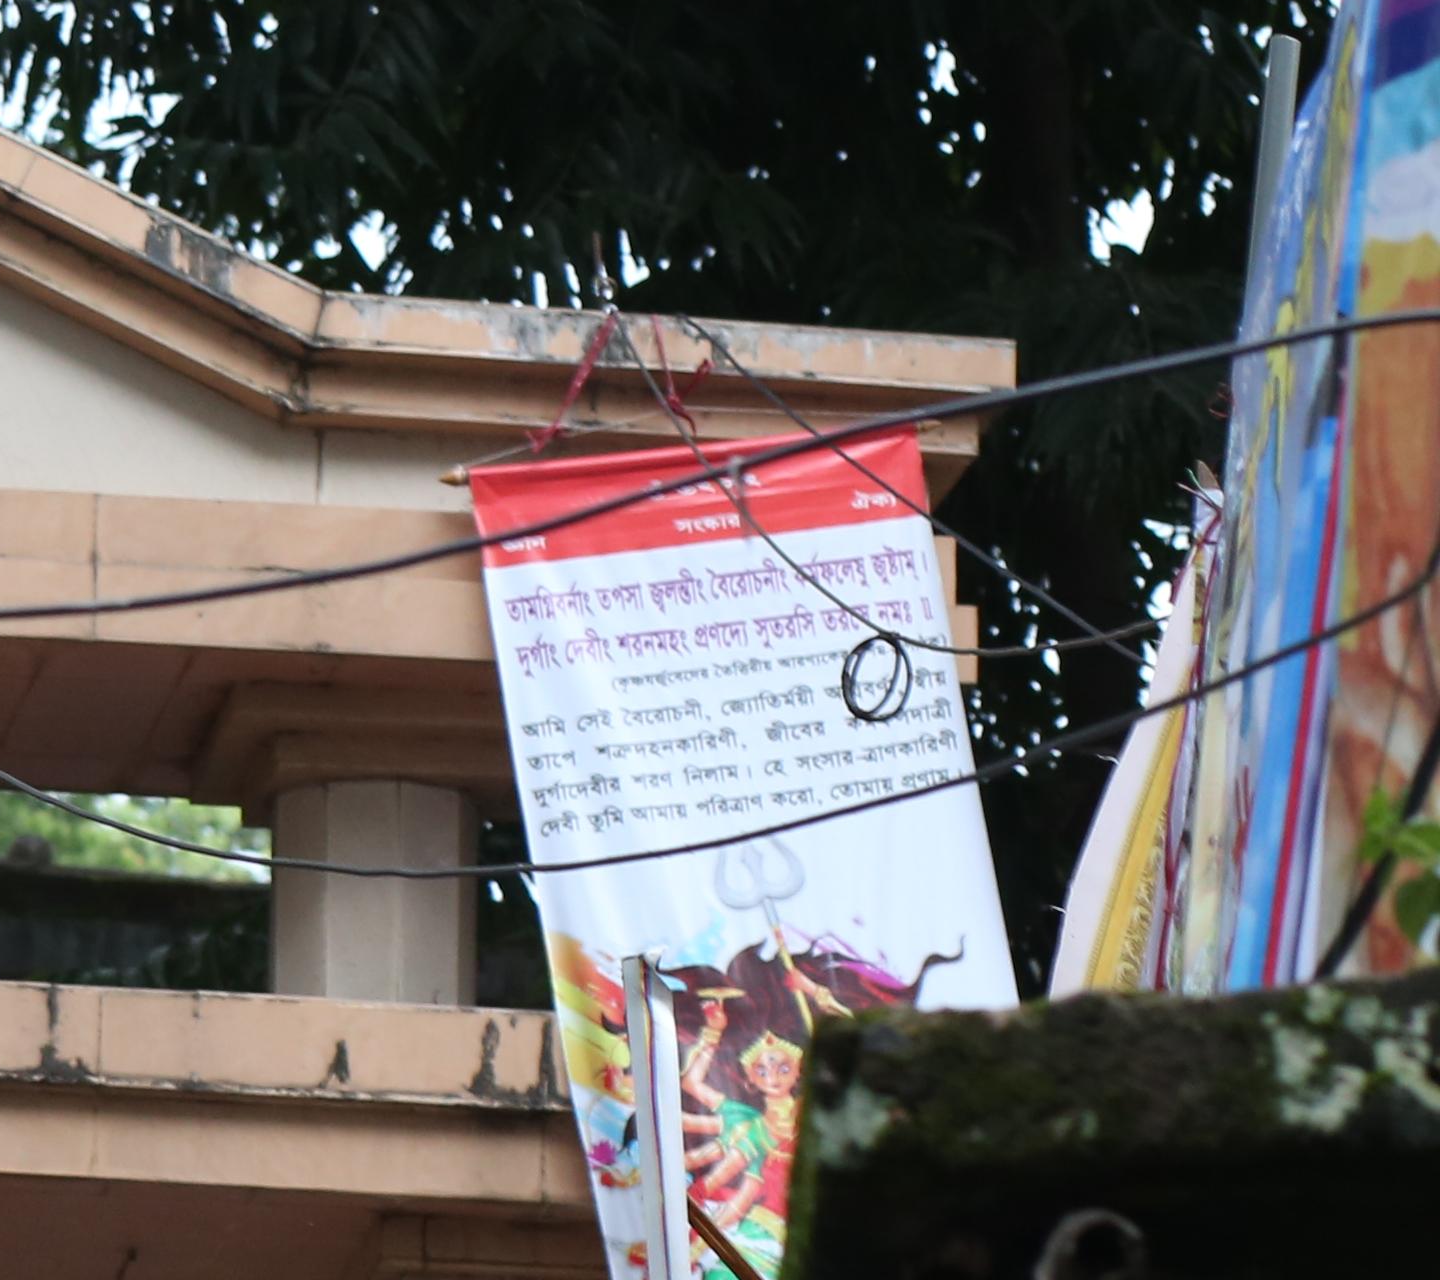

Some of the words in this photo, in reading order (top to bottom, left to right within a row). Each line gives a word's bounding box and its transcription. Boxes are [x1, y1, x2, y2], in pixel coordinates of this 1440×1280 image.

[521, 715, 567, 738] আমি
[576, 707, 613, 733] সেই
[526, 749, 578, 772] তাপে
[764, 717, 826, 743] জীবের
[683, 763, 740, 787] নিলাম
[540, 810, 580, 838] দেবী
[587, 804, 625, 834] তুমি
